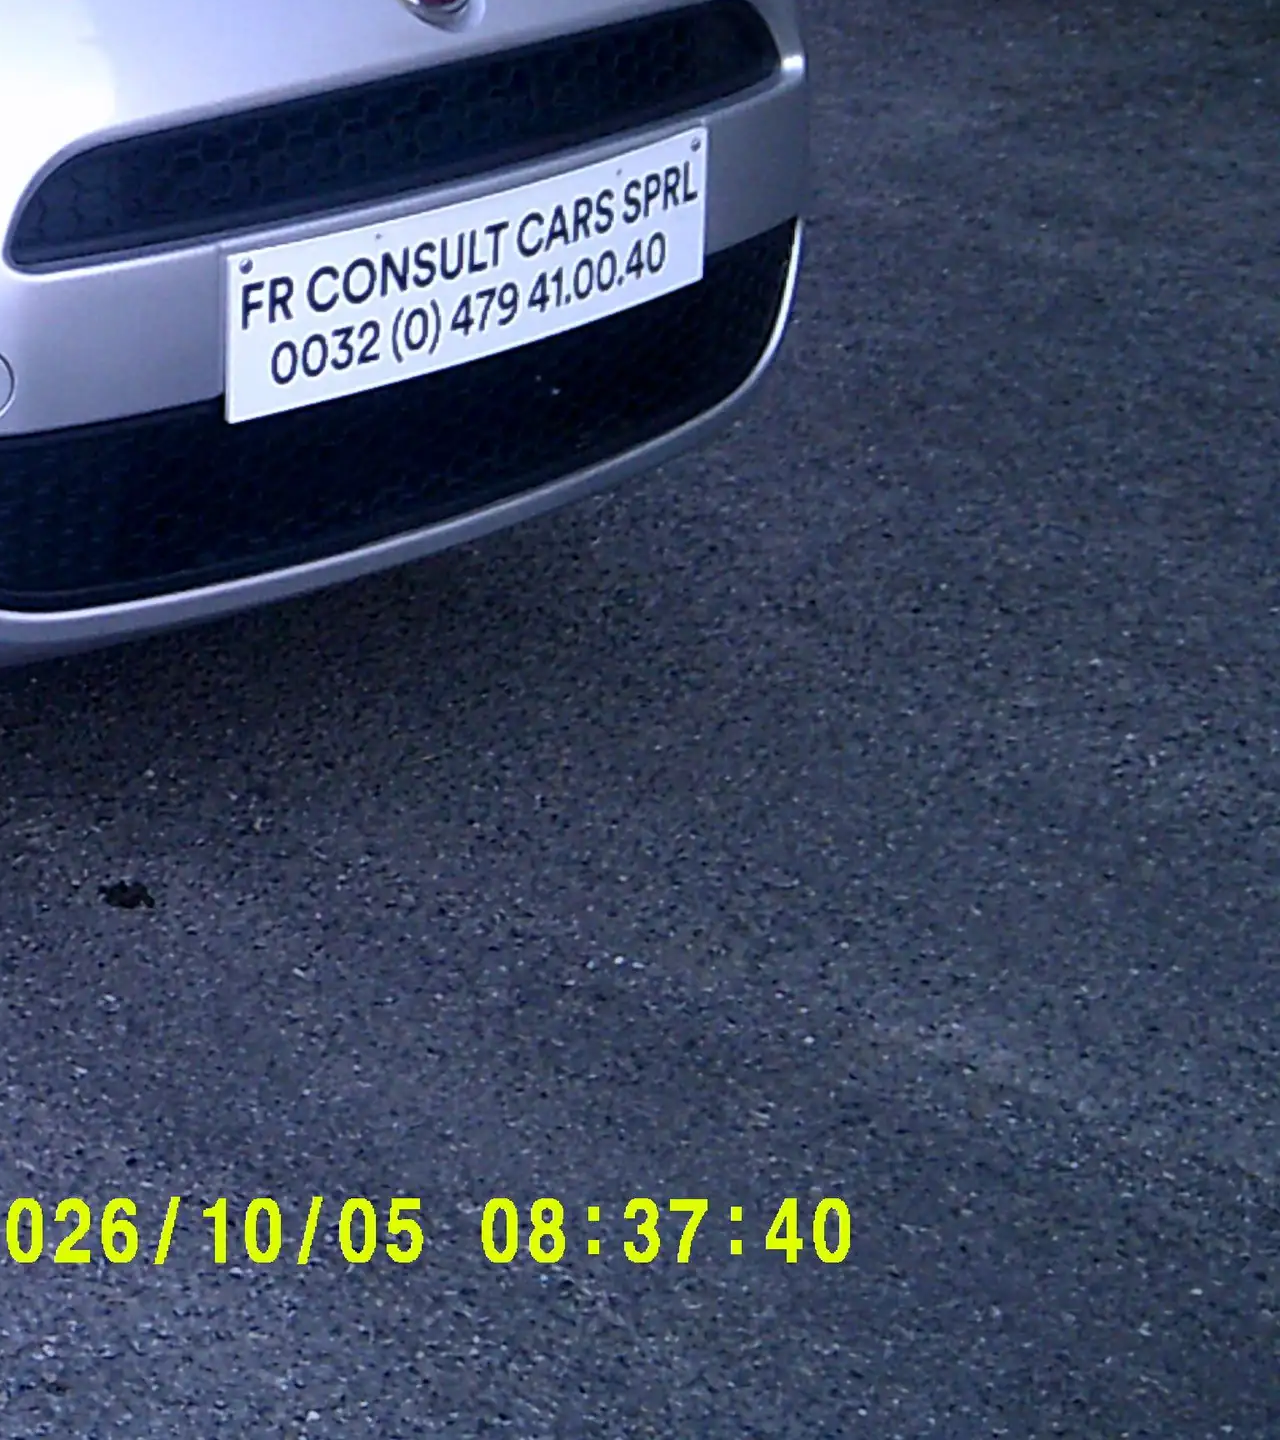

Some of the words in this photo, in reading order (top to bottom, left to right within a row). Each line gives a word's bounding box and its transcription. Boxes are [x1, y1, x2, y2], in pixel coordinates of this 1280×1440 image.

[240, 276, 294, 330] FR
[306, 221, 510, 313] CONSULT
[516, 188, 615, 258] CARS
[622, 161, 698, 224] SPRL
[271, 320, 380, 385] 0032
[391, 299, 441, 363] (0)
[450, 282, 520, 336] 479
[527, 231, 666, 313] 41.00.40
